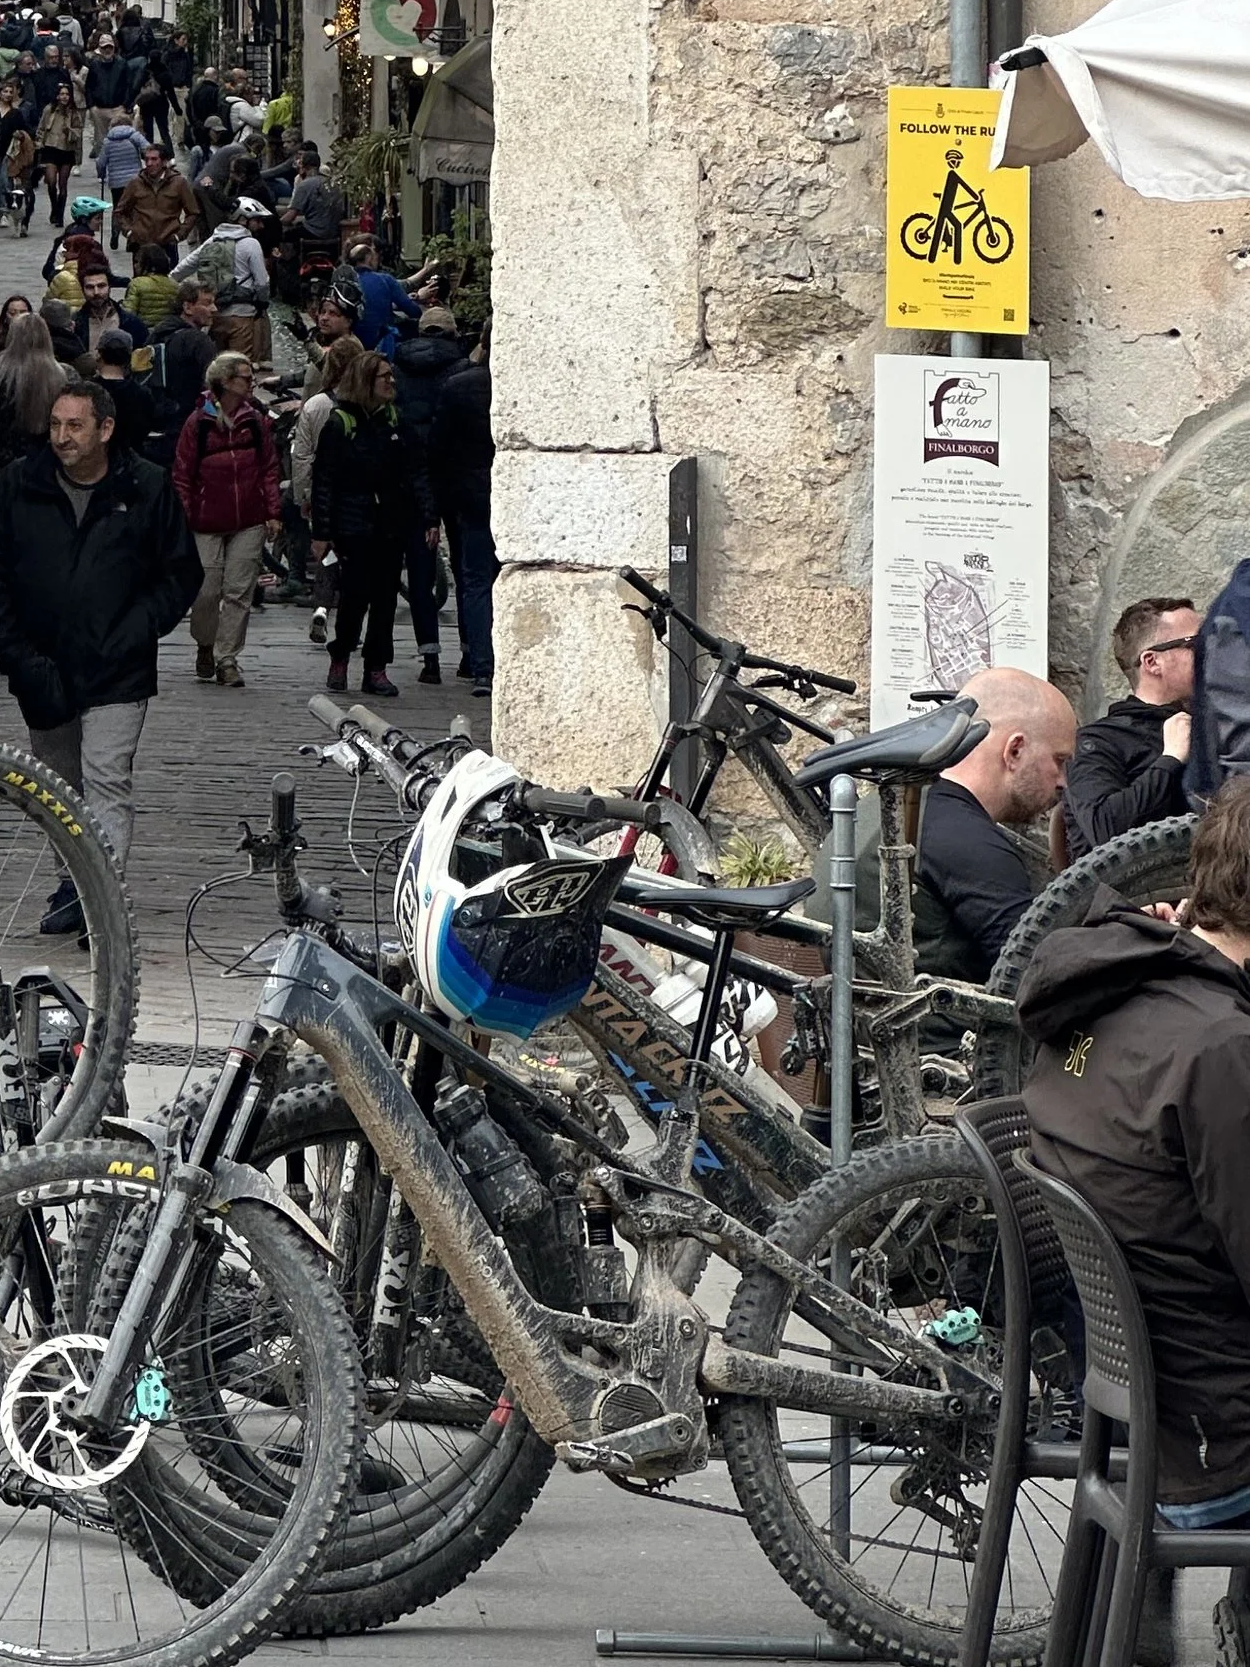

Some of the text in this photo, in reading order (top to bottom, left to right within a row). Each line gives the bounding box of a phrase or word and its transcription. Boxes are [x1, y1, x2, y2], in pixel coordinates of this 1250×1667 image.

[899, 122, 951, 135] FOLLOW
[954, 125, 977, 136] THE
[956, 406, 968, 417] a
[945, 417, 992, 429] mano
[928, 442, 995, 455] FINALBORGO
[3, 771, 83, 836] MAXXIS
[372, 1245, 411, 1329] FOX
